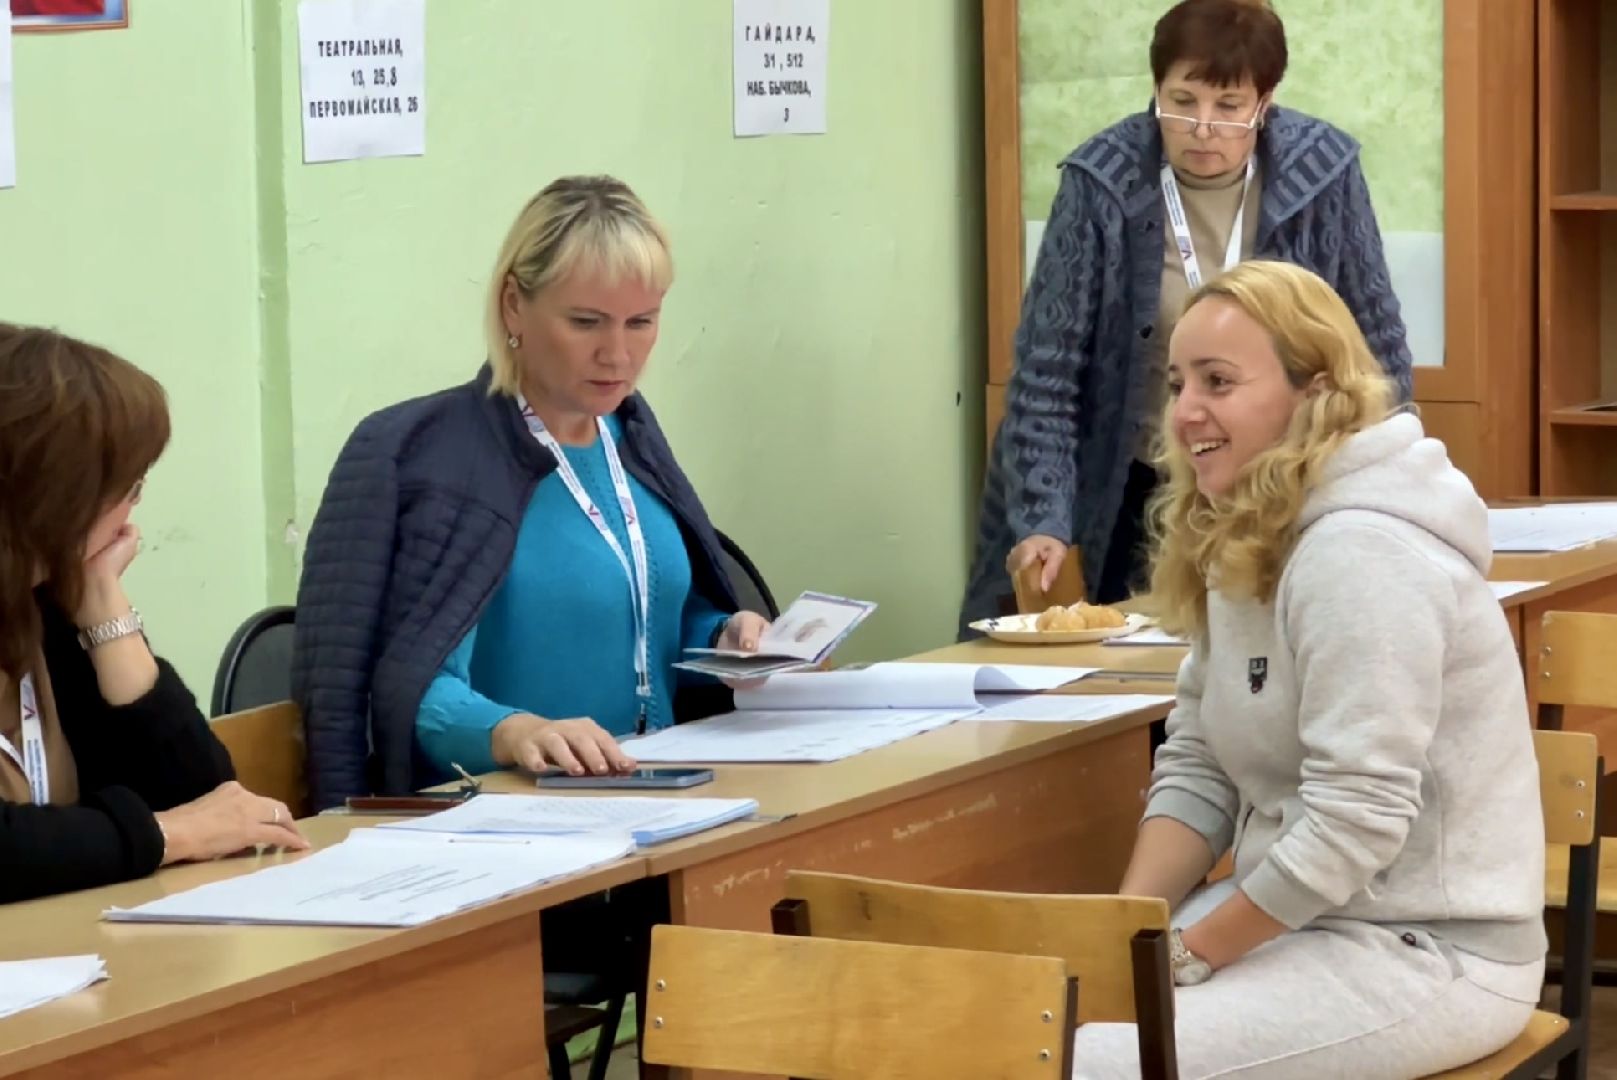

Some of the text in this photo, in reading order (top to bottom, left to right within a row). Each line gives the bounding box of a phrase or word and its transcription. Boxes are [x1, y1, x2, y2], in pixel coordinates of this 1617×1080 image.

[745, 23, 816, 44] ГАЙДАРА,
[317, 38, 403, 57] ТЕАТРАЛЬНАЯ,
[309, 96, 402, 118] ПЕРВОМАЙСКАЯ,
